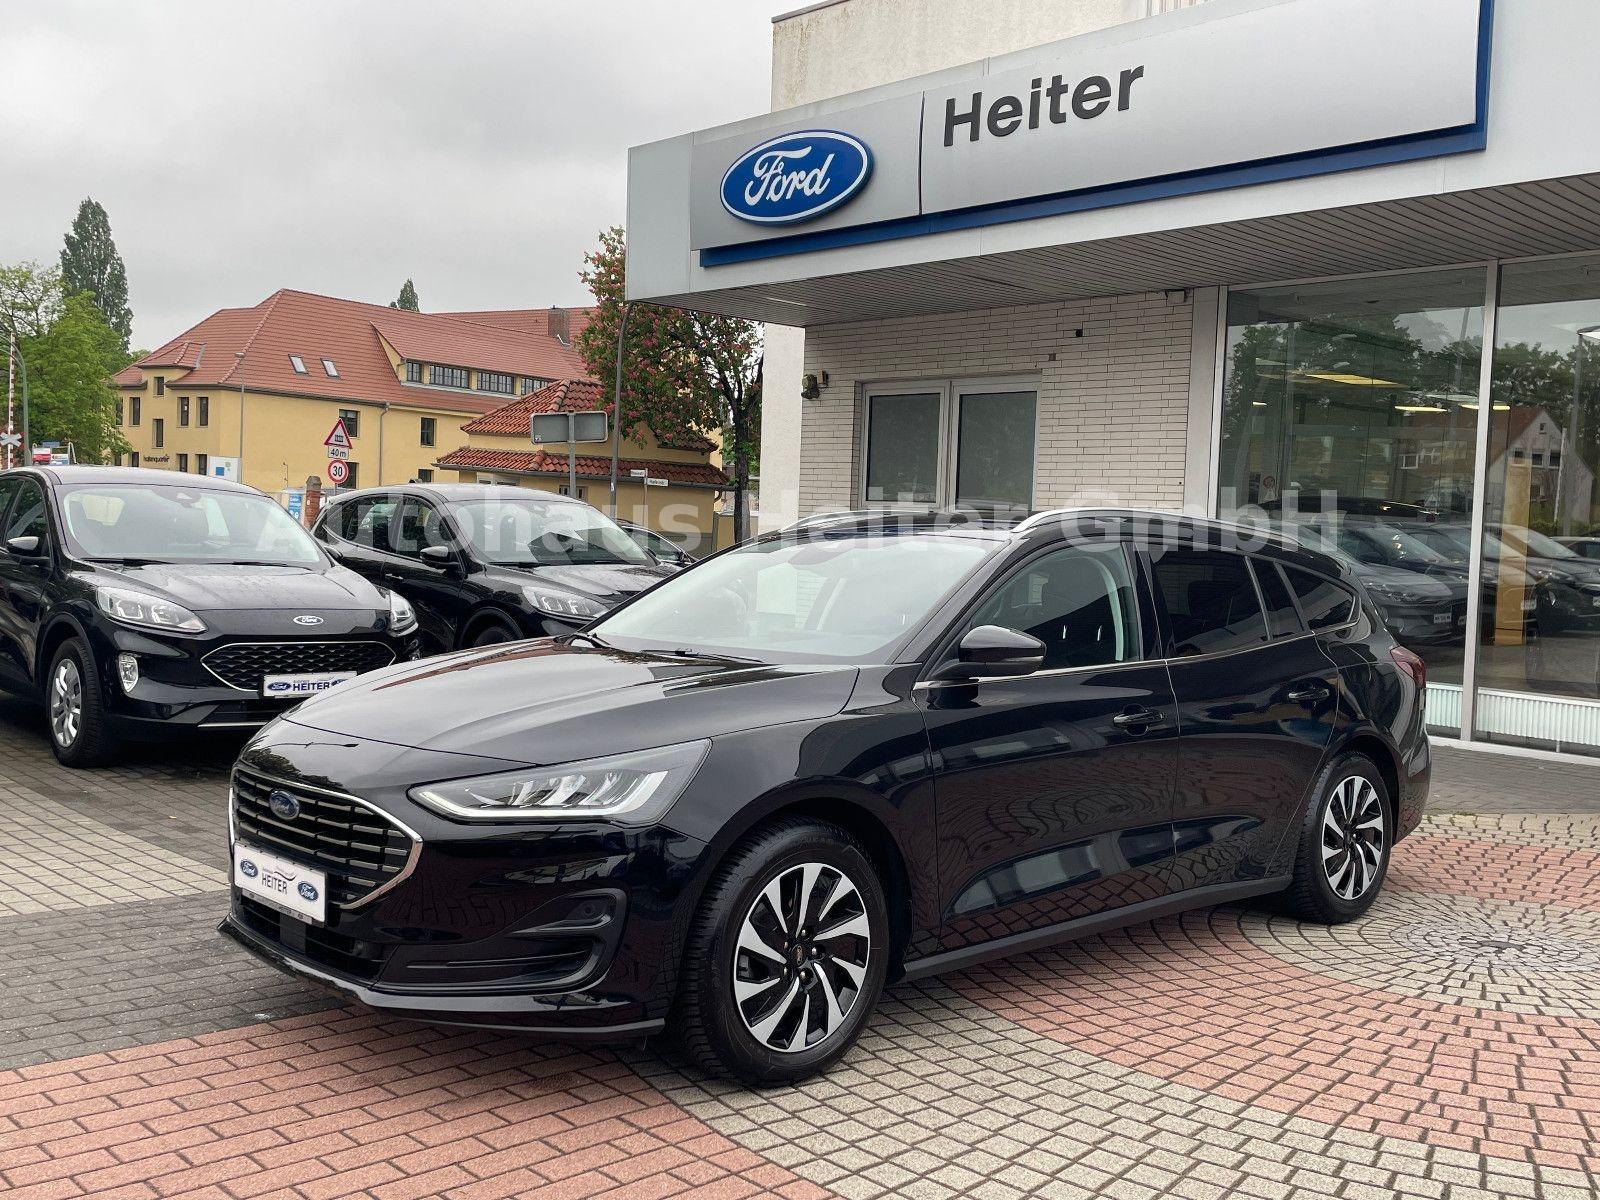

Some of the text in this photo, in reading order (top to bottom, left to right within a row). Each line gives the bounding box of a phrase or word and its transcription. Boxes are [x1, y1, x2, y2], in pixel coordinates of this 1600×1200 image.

[943, 65, 1145, 147] Heiter
[744, 145, 835, 206] Ford
[332, 465, 343, 477] 30
[293, 682, 330, 692] HEITER
[262, 872, 287, 895] HEITER
